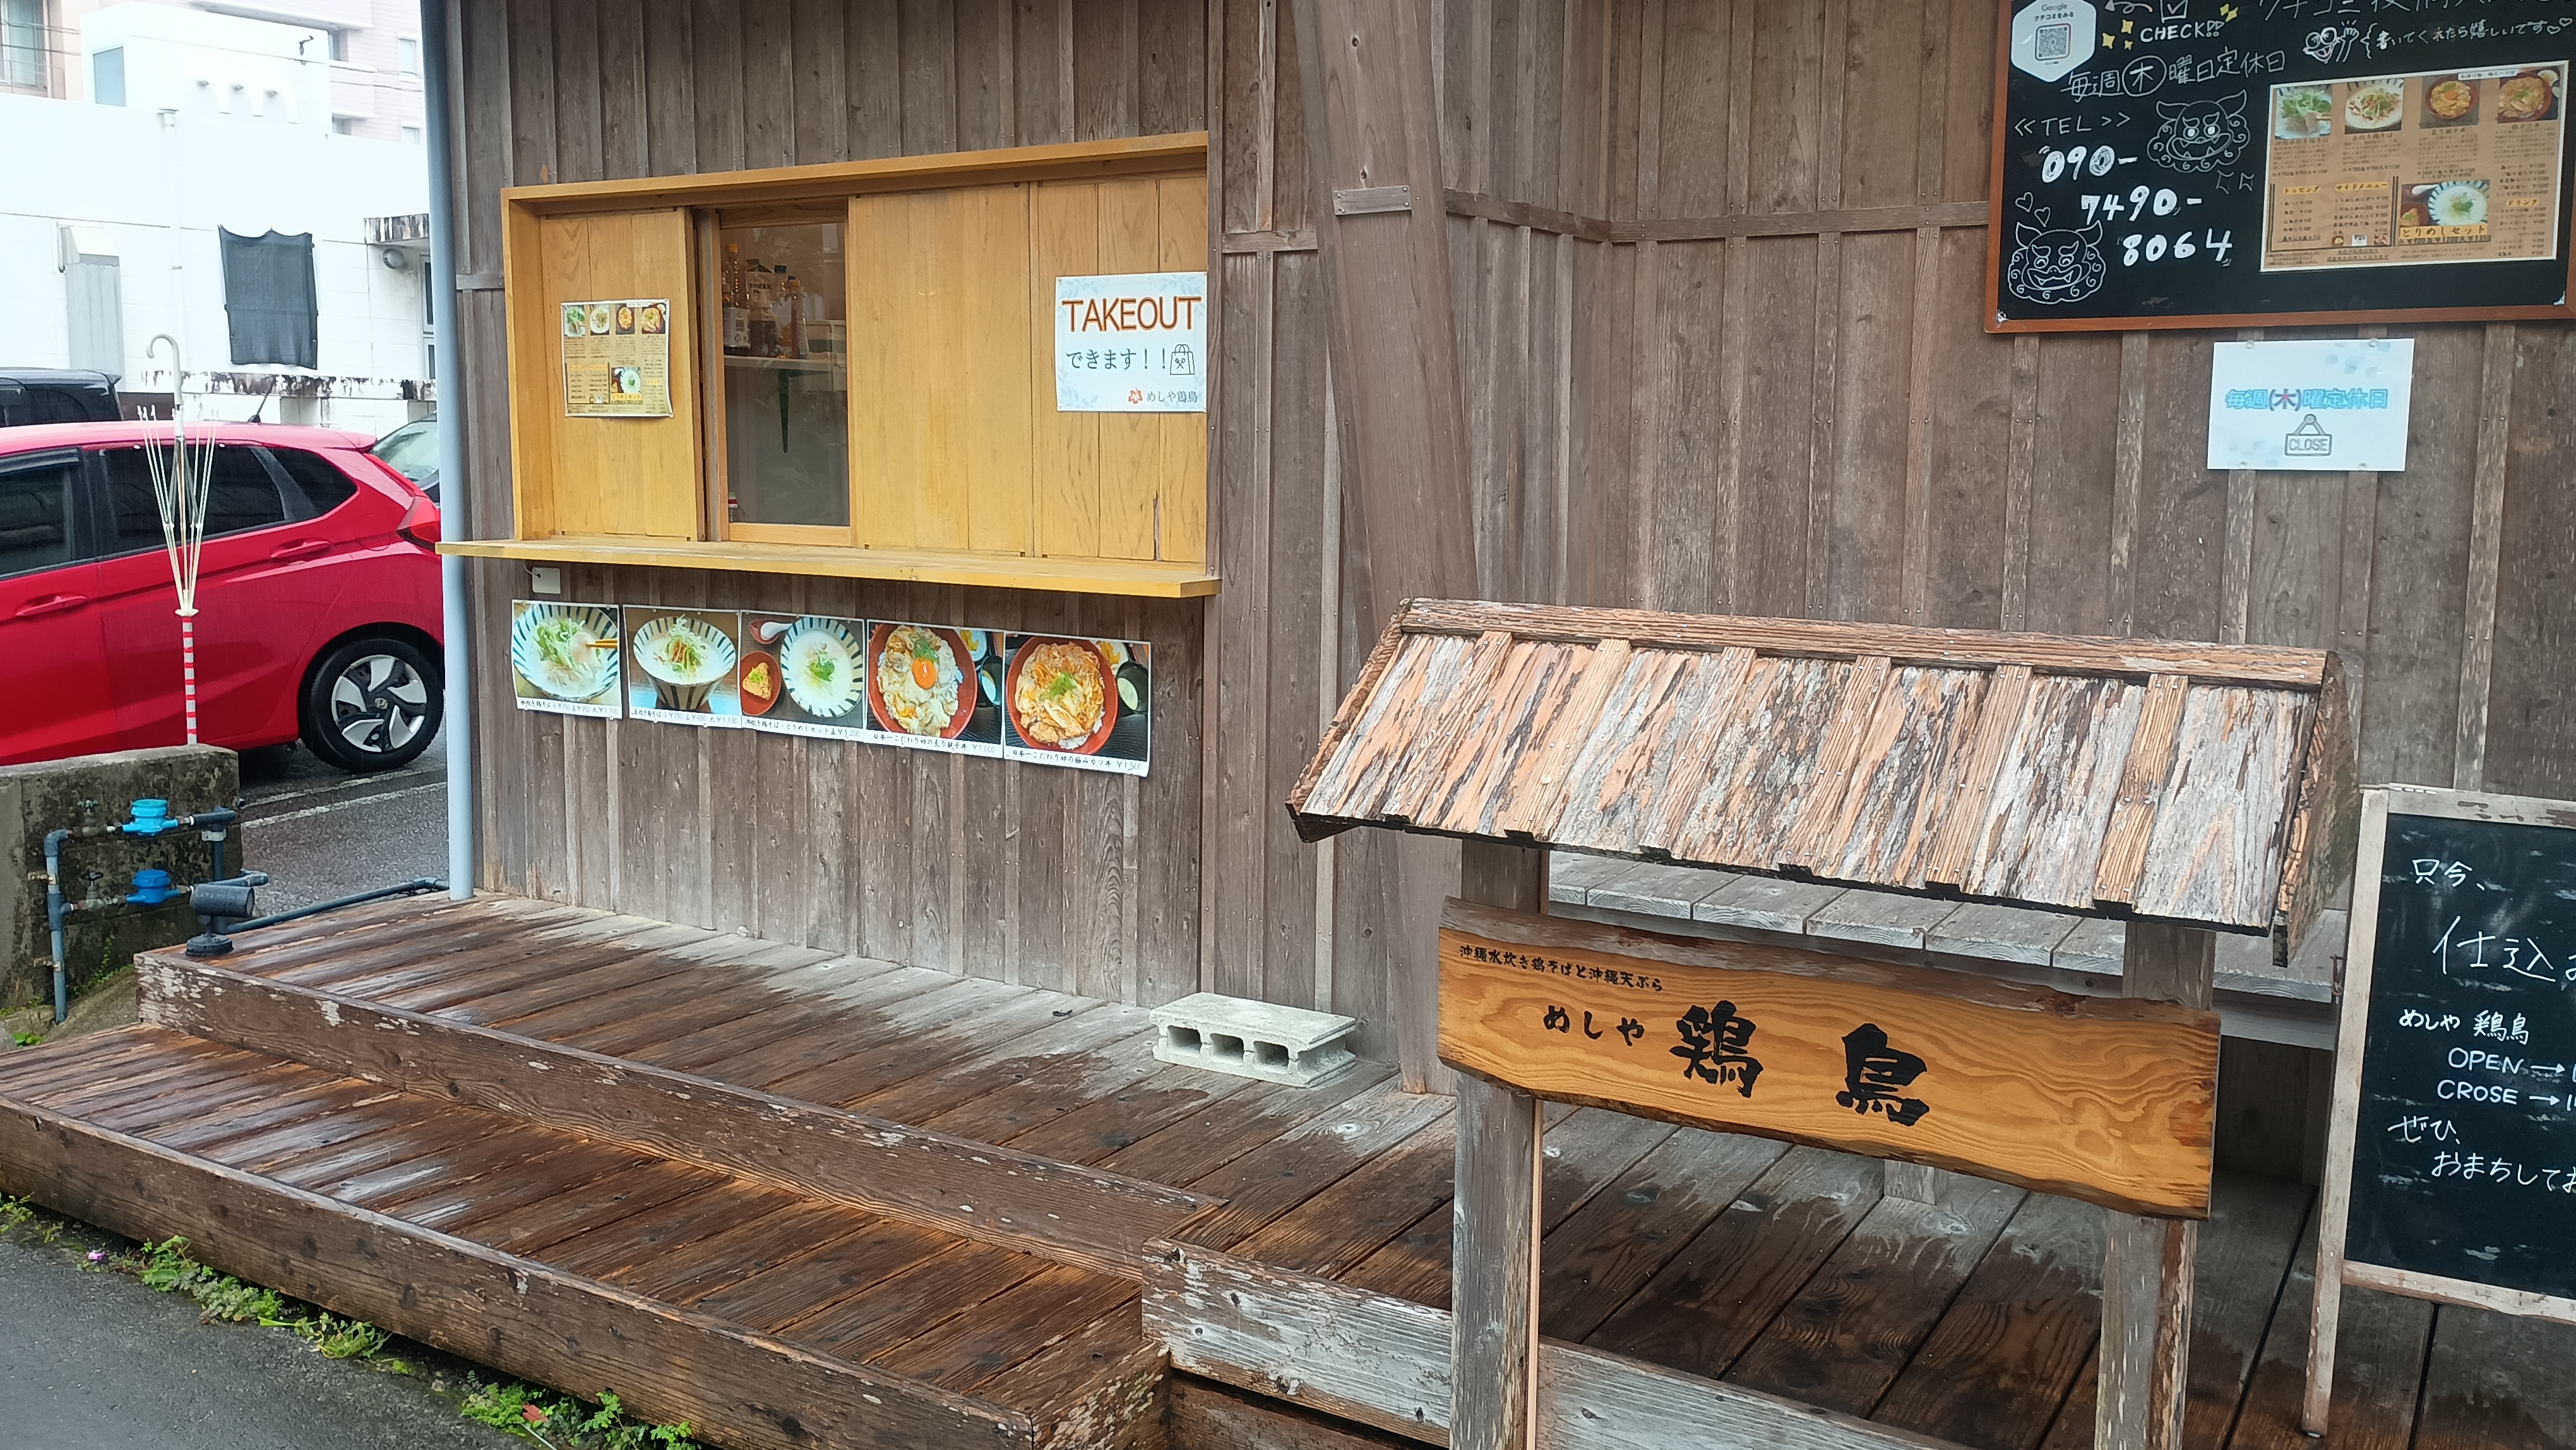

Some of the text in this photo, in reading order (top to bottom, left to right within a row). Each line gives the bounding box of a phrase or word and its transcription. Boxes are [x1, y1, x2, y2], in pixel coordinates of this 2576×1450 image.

[2041, 2, 2068, 12] Google
[2402, 225, 2486, 237] とりめしセット
[2123, 227, 2233, 267] 8064
[1061, 296, 1202, 333] TAKEOUT
[1147, 390, 1198, 403] めしや鶏鳥
[2288, 438, 2329, 452] CLOSE
[1542, 1005, 1645, 1046] めしや
[2399, 1009, 2460, 1031] めしや
[2448, 1046, 2525, 1074] OPEN
[2437, 1079, 2519, 1105] CROSE
